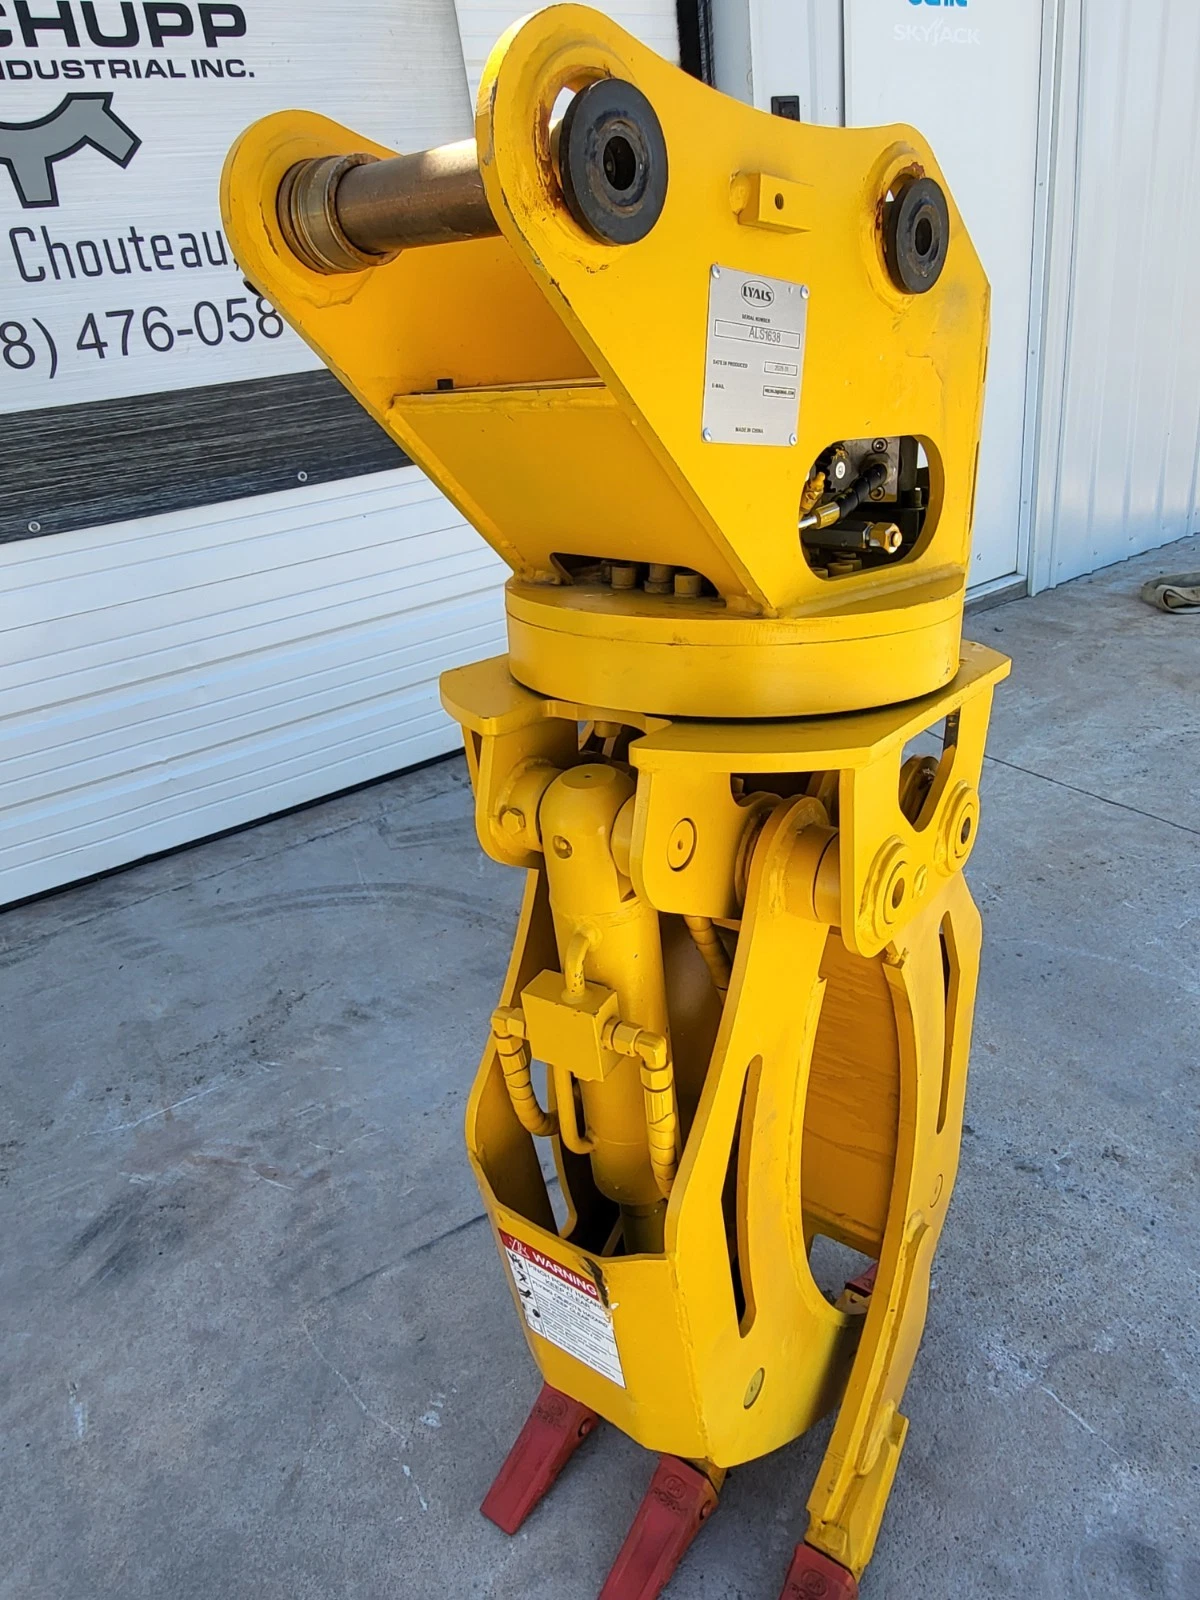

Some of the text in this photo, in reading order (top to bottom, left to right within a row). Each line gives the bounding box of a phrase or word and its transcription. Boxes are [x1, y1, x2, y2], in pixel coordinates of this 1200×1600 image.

[0, 0, 247, 48] HUPP
[893, 17, 981, 47] SKYJACK
[193, 59, 255, 78] INC.
[743, 286, 773, 302] LYALS
[755, 316, 771, 324] NUMBER
[748, 326, 781, 343] ALS1638
[531, 1251, 597, 1296] WARNING
